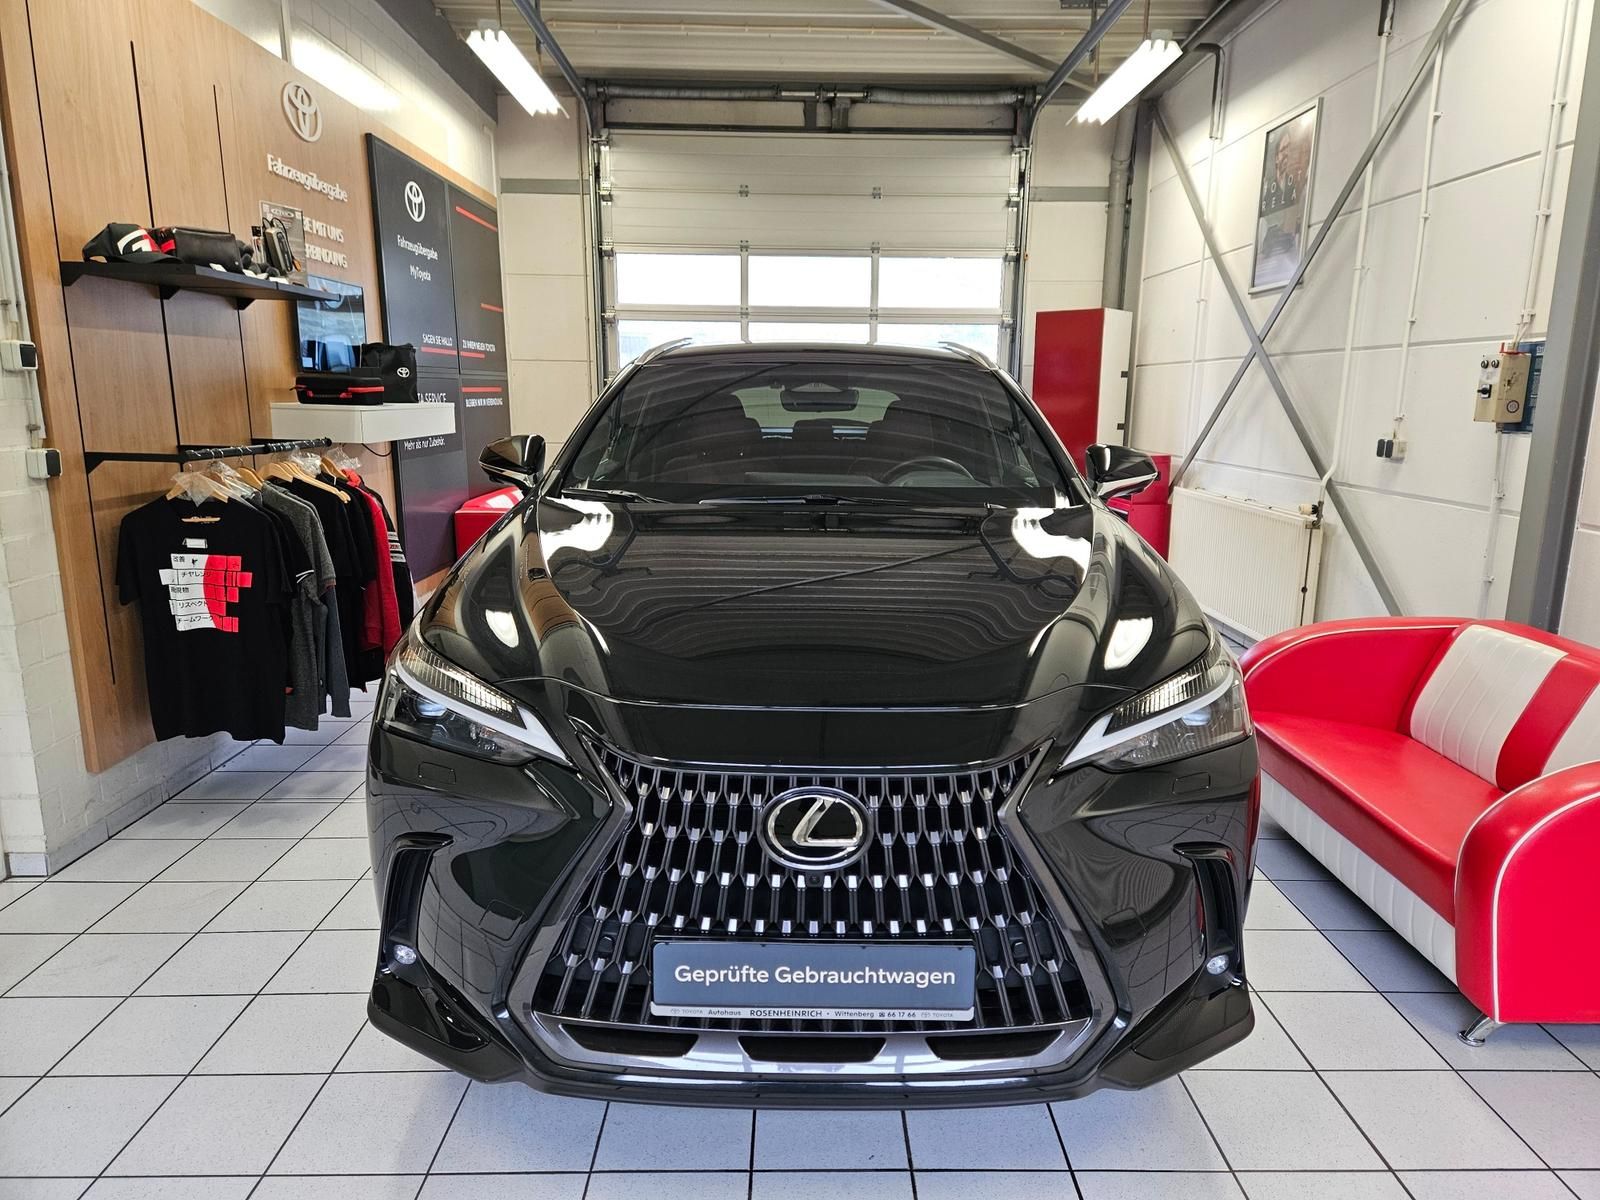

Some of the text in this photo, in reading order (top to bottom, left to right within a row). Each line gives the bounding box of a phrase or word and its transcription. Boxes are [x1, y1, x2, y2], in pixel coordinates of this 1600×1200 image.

[674, 965, 956, 988] Geprüfte Gebrauchtwagen
[707, 1008, 742, 1016] Autohaus
[749, 1009, 823, 1018] ROSENHEINRICH
[834, 1010, 875, 1019] Wittenberg
